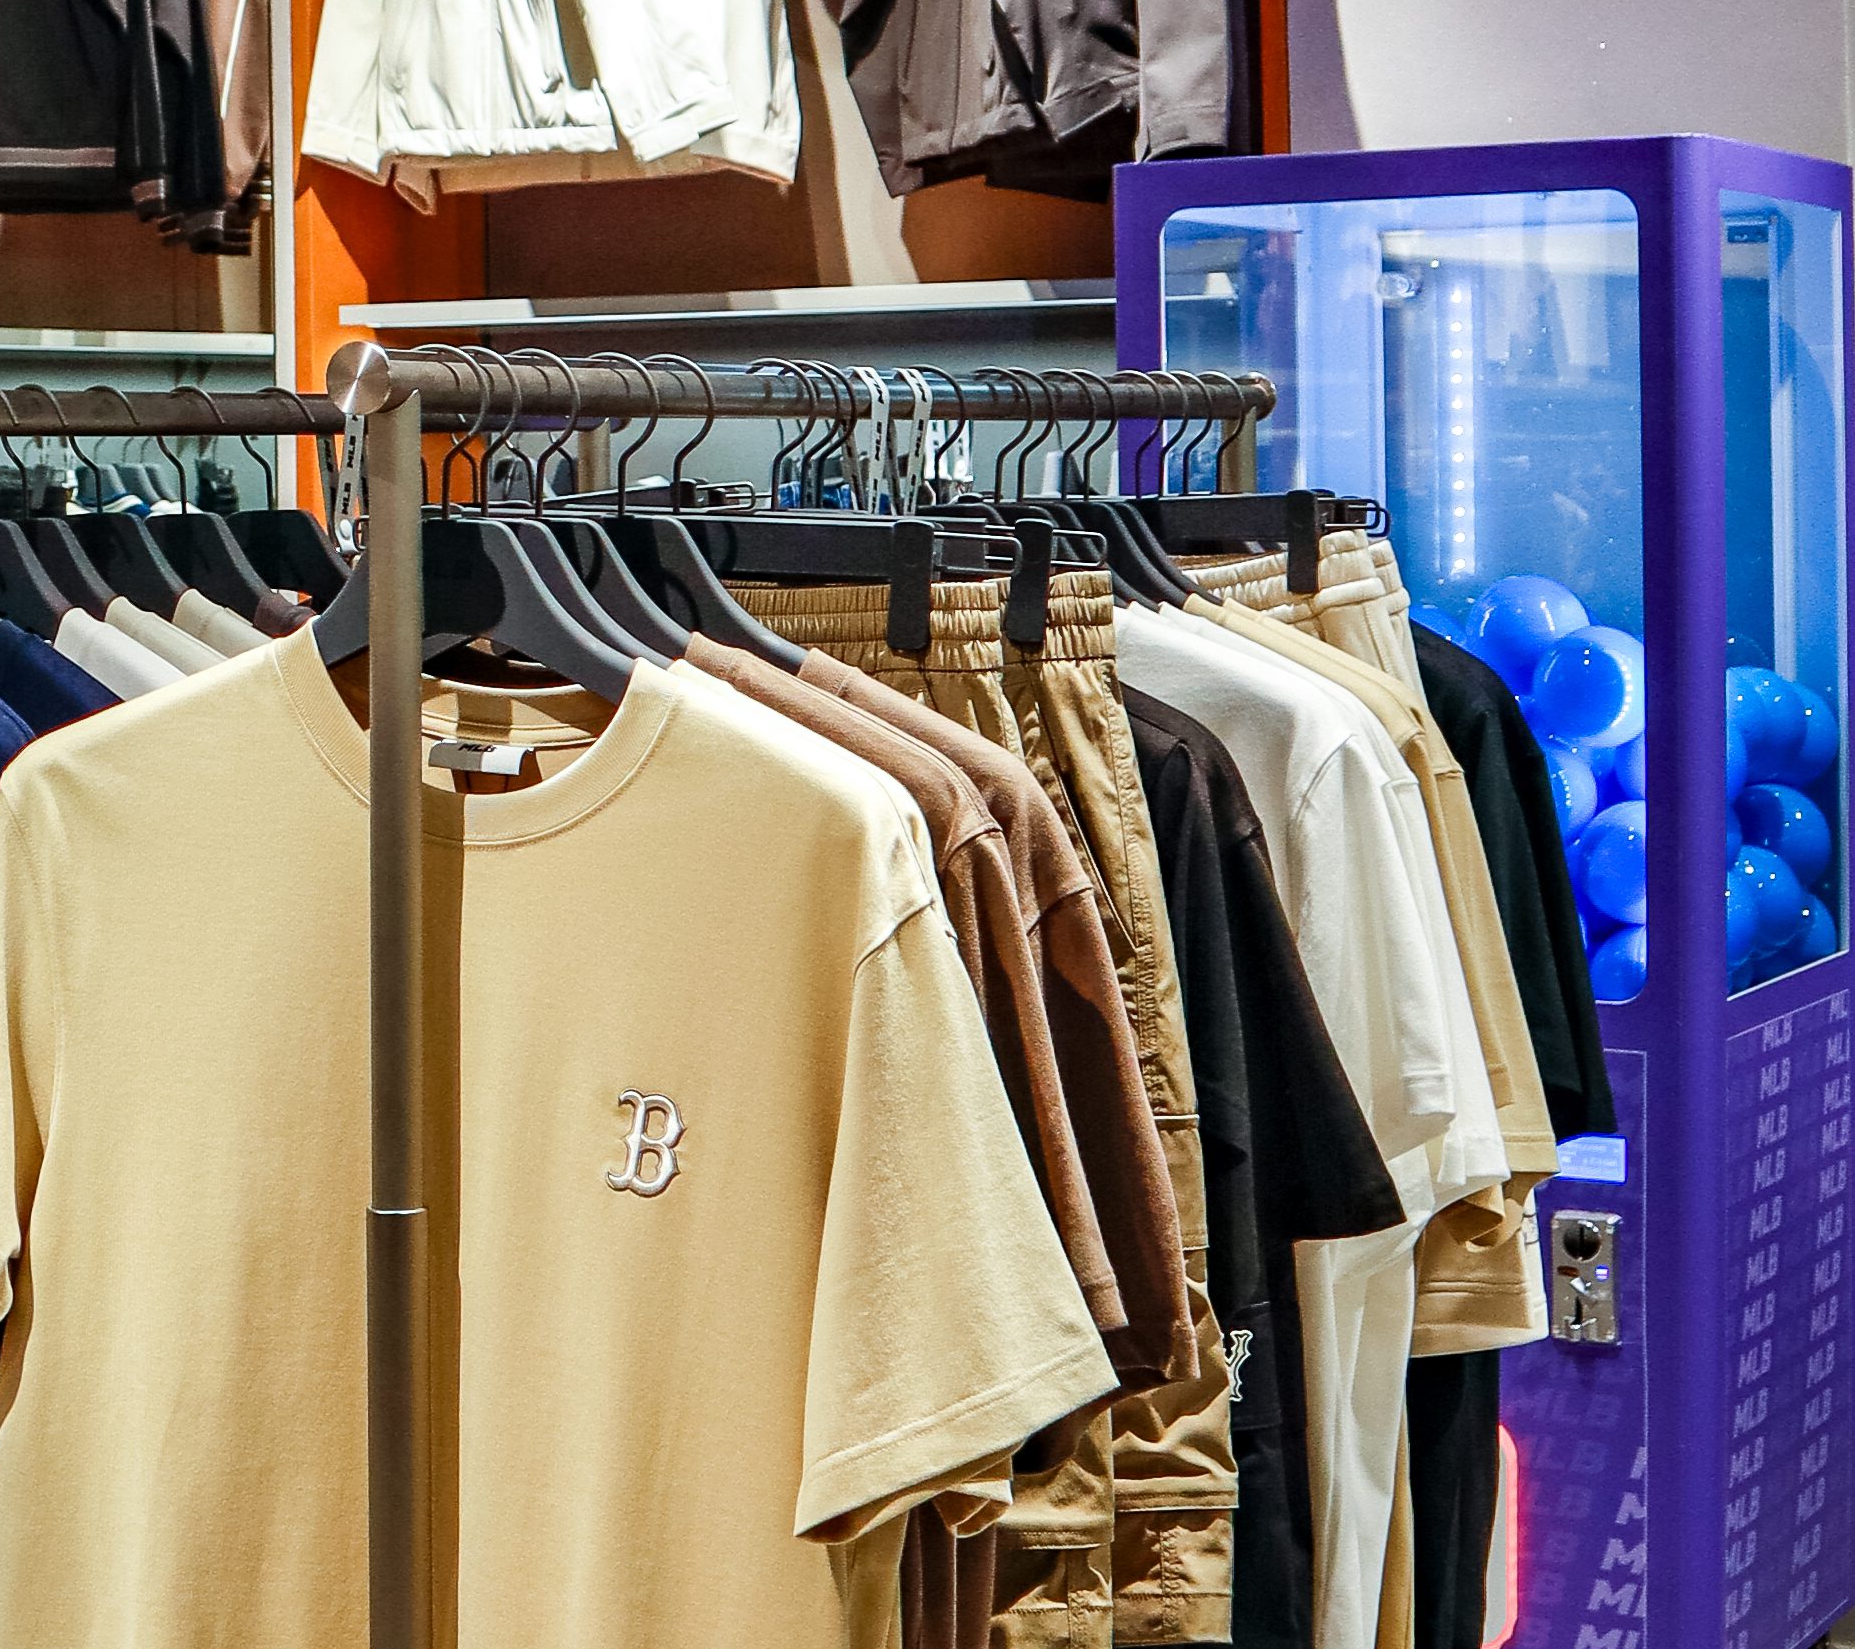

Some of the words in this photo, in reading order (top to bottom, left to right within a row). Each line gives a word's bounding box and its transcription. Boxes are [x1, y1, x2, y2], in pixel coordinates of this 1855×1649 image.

[1761, 1057, 1791, 1100] MLB
[607, 1086, 688, 1198] B
[1757, 1104, 1788, 1148] MLB
[1753, 1148, 1785, 1193] MLB
[1819, 1159, 1847, 1202] MLB
[1750, 1195, 1782, 1241] MLB
[1816, 1204, 1844, 1250] MLB
[1746, 1243, 1779, 1291] MLB
[1813, 1250, 1841, 1296] MLB
[1742, 1290, 1776, 1340] MLB
[1809, 1295, 1839, 1340] MLB
[1738, 1338, 1772, 1388] MLB
[1806, 1341, 1836, 1388] MLB
[1733, 1387, 1769, 1438] MLB
[1803, 1387, 1832, 1434] MLB
[1729, 1436, 1765, 1488] MLB
[1800, 1434, 1829, 1483] MLB
[1796, 1477, 1826, 1525] MLB
[1792, 1524, 1822, 1574] MLB
